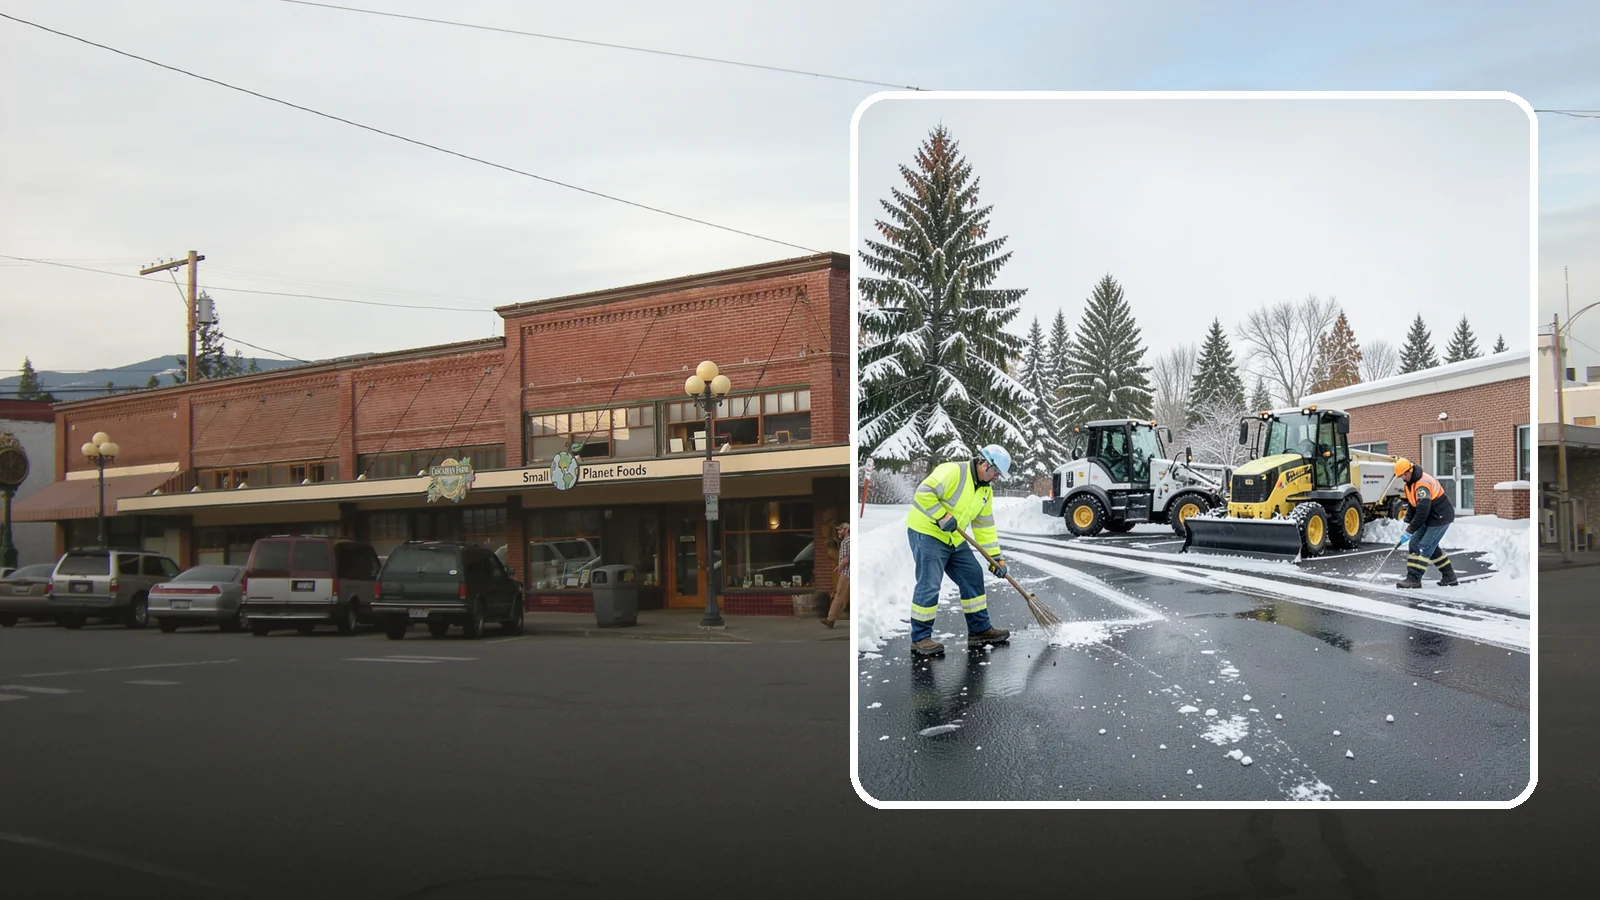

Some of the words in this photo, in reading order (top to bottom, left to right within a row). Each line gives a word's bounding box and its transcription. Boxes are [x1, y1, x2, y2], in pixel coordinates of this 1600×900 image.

[523, 471, 548, 483] Small
[583, 467, 614, 479] Planet
[617, 464, 647, 476] Foods
